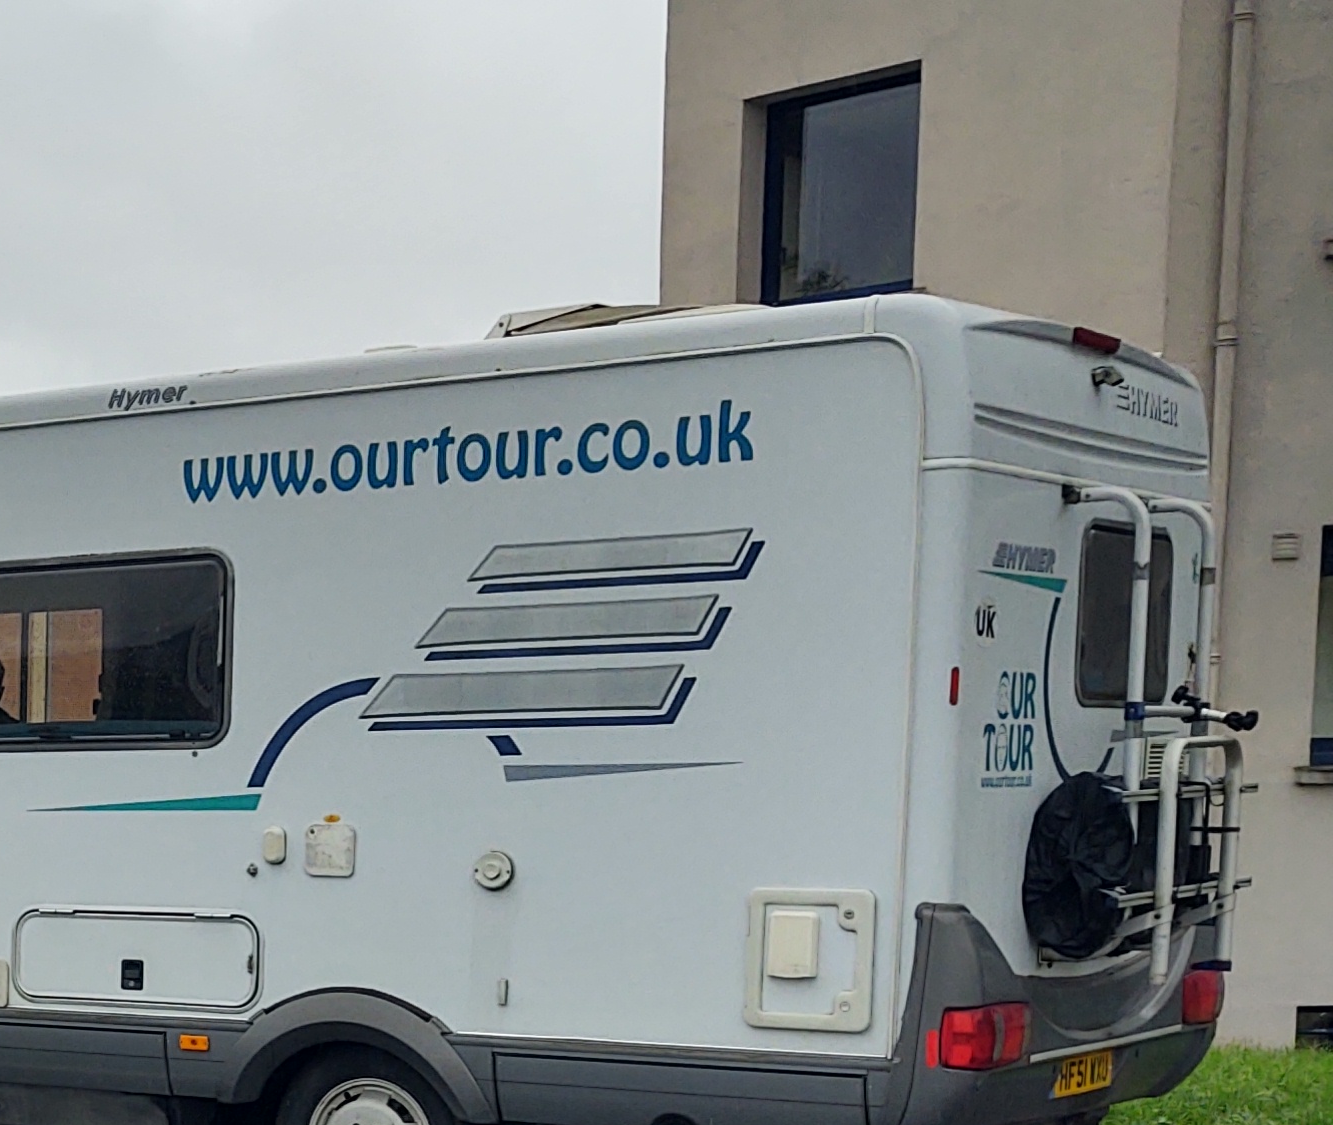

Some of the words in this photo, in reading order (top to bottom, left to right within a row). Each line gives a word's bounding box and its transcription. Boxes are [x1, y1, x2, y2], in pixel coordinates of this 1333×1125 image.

[107, 384, 188, 411] Hymer
[1131, 386, 1178, 427] HYMER
[183, 399, 754, 503] www.ourtour.co.uk
[1006, 544, 1057, 574] HYMER
[975, 605, 997, 639] UK
[983, 723, 1034, 772] TOUR
